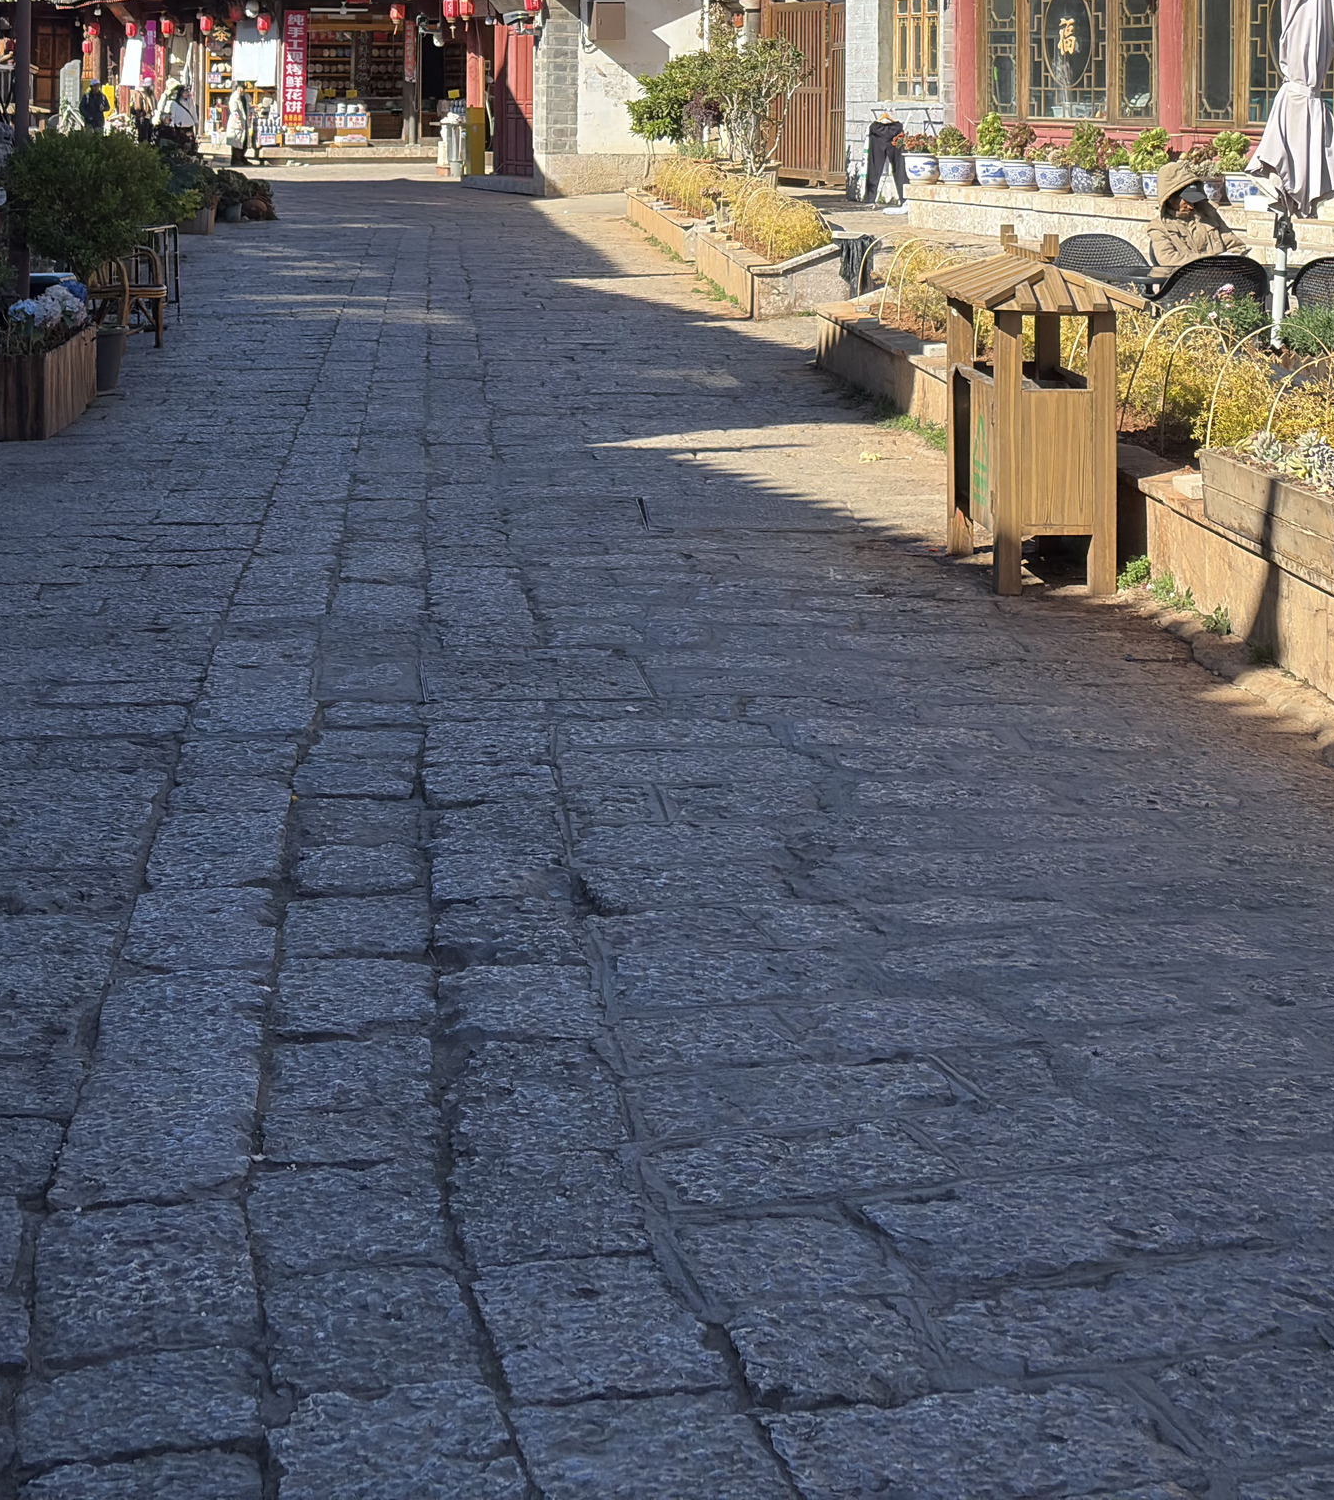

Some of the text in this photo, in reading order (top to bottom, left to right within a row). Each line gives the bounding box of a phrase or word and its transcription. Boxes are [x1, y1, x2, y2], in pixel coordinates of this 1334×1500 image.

[212, 25, 232, 42] 茶
[1057, 17, 1076, 56] 福
[284, 14, 305, 113] 纯手工现烤鲜花饼
